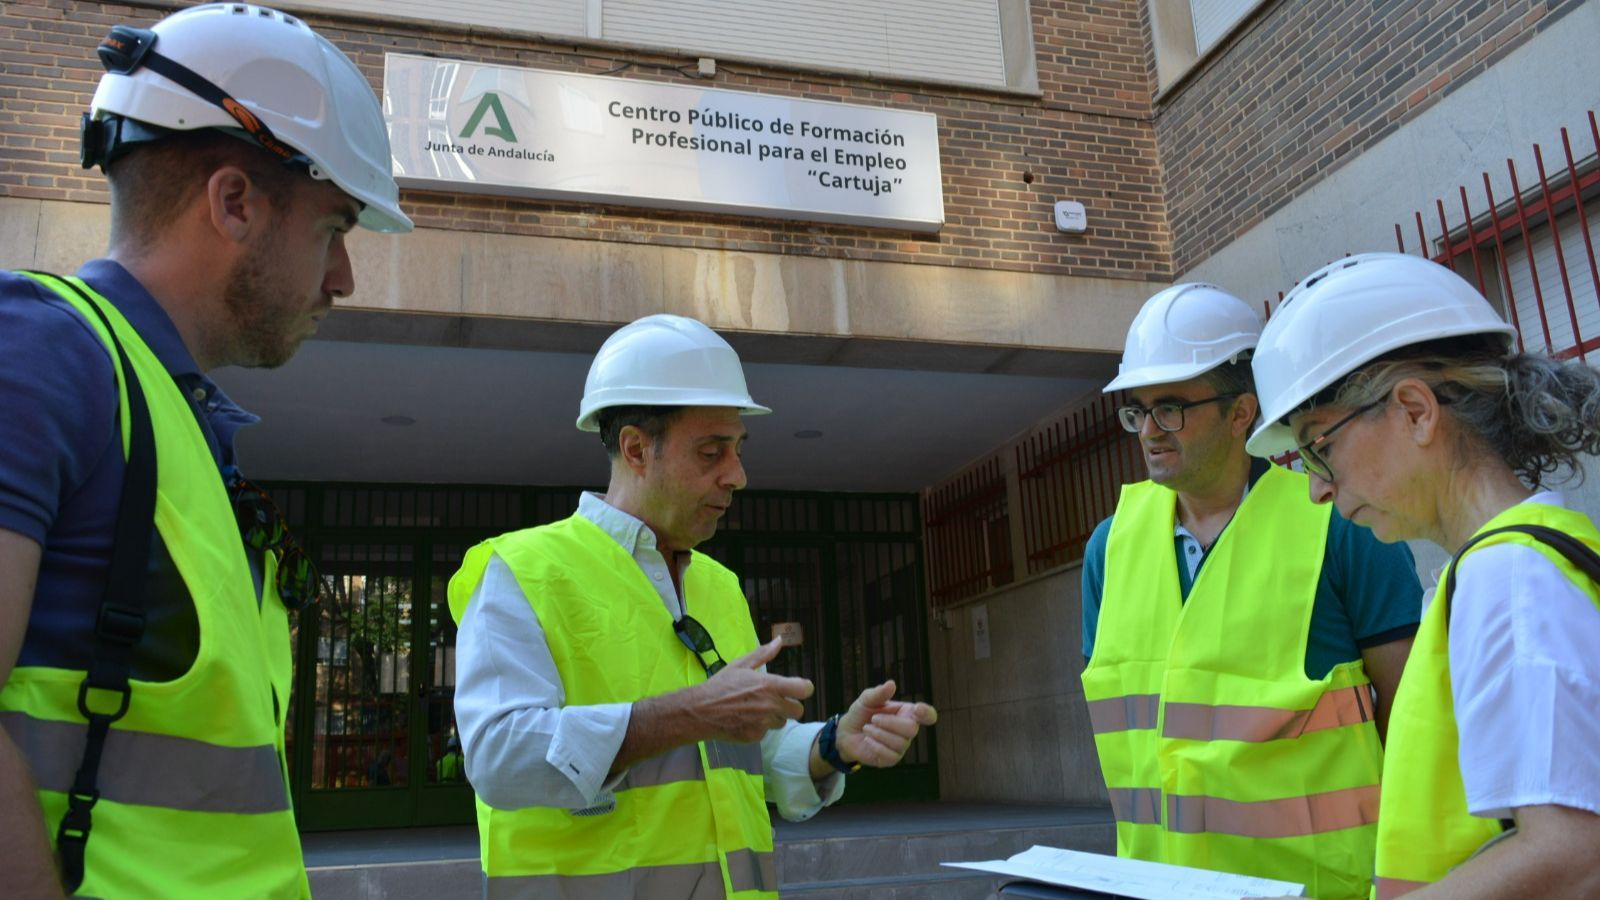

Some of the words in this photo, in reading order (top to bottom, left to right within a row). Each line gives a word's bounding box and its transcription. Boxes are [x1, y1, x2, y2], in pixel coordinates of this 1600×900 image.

[608, 101, 681, 123] Centro
[688, 108, 764, 132] Público
[770, 118, 794, 135] de
[801, 121, 905, 147] Formación
[425, 141, 464, 154] Junta
[468, 144, 484, 156] de
[488, 146, 555, 162] Andalucía
[632, 128, 752, 155] Profesional
[758, 144, 804, 161] para
[811, 147, 828, 163] el
[835, 149, 907, 171] Empleo
